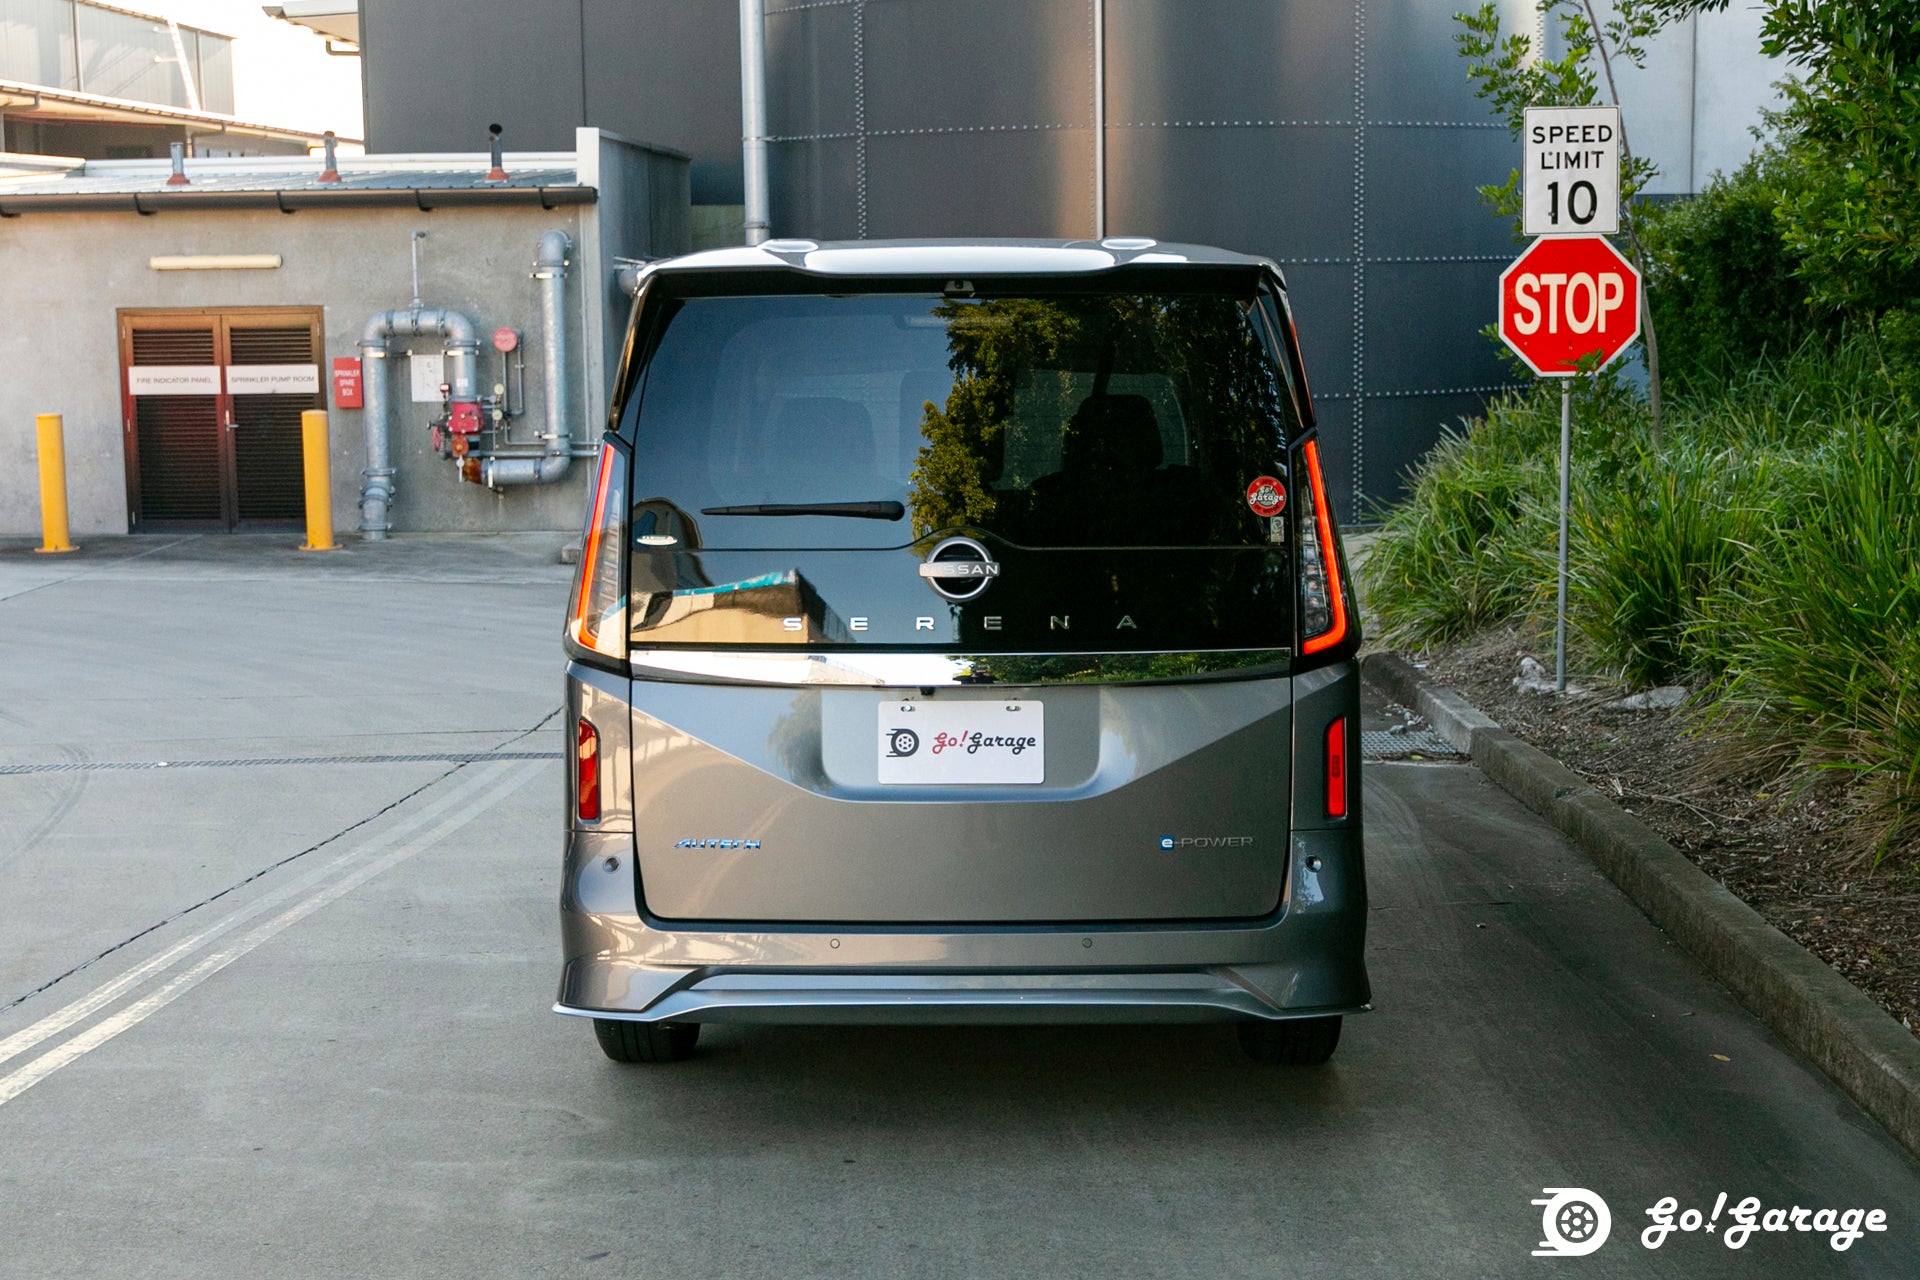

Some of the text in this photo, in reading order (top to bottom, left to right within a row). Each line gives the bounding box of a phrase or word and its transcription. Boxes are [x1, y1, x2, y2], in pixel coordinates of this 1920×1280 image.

[1532, 125, 1612, 144] SPEED
[1541, 151, 1604, 170] LIMIT
[1547, 180, 1597, 225] 10
[1513, 272, 1624, 335] STOP
[1249, 492, 1284, 505] Garage
[783, 615, 1138, 631] SERENA
[673, 838, 761, 850] AUTECH
